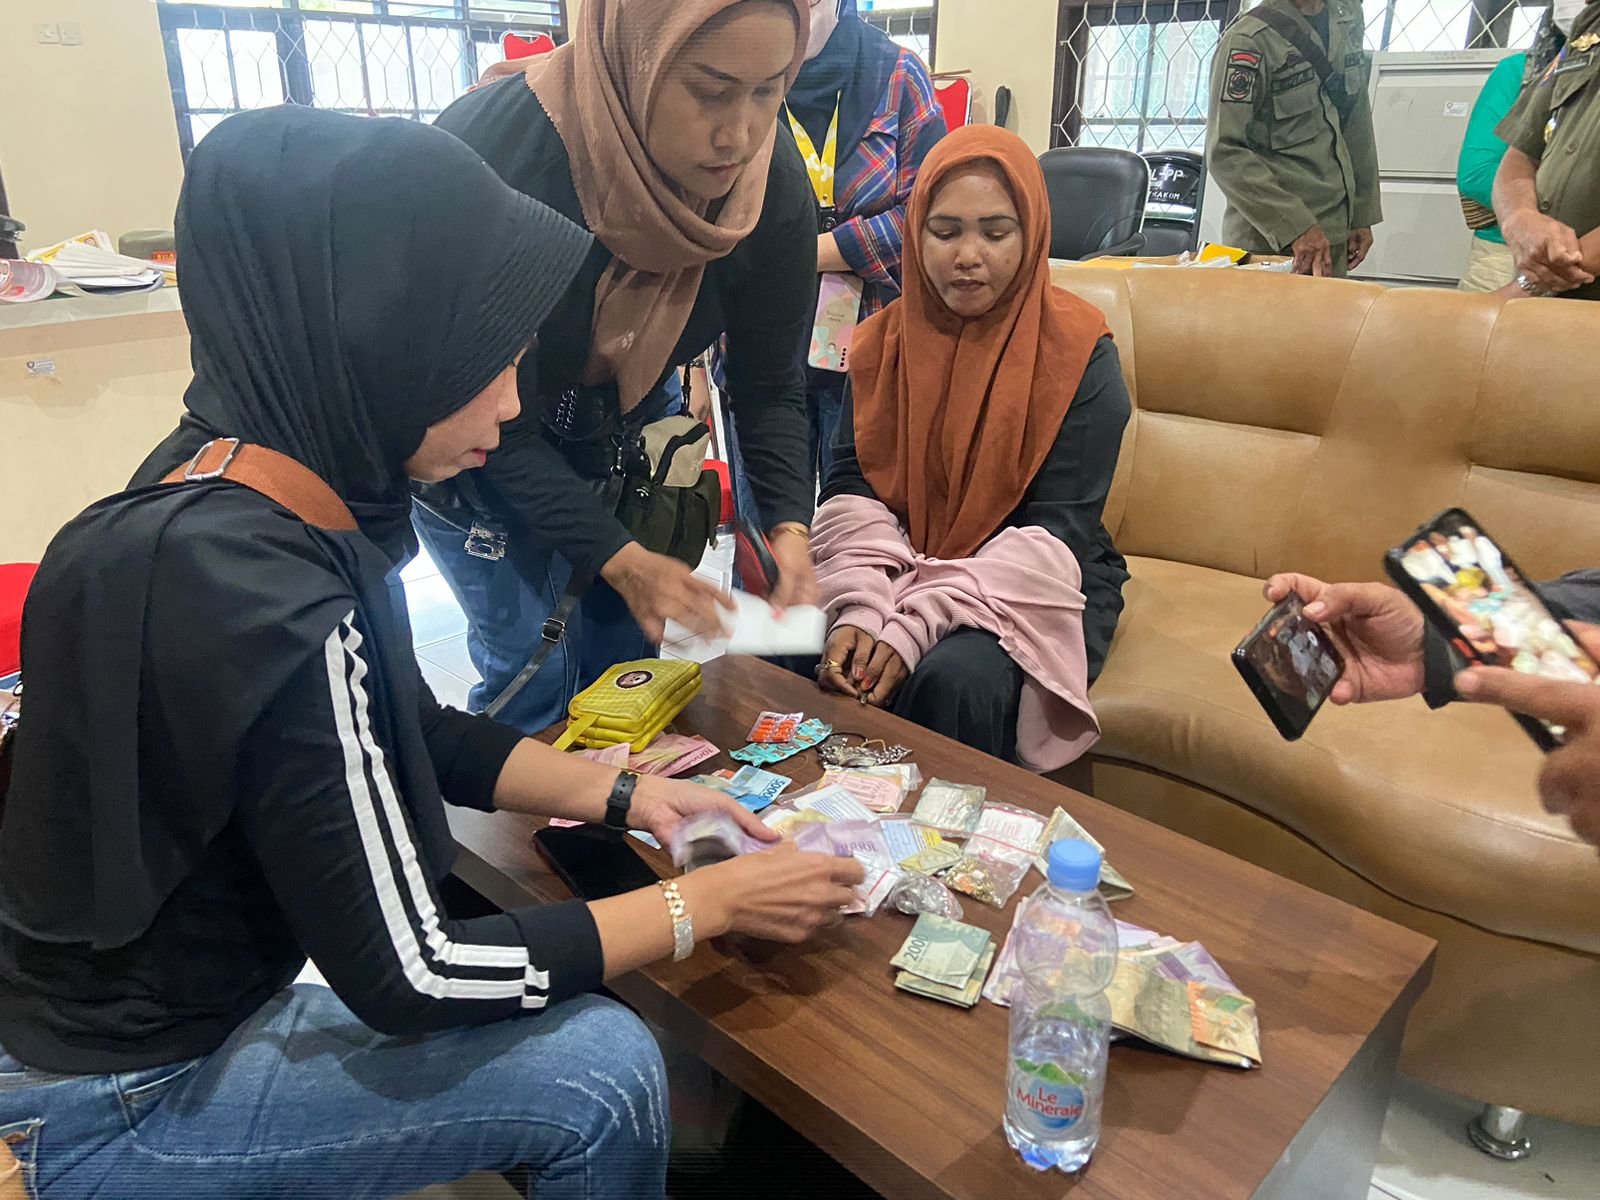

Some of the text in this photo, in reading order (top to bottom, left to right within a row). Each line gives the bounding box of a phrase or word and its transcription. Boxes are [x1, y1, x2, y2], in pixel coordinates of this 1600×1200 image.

[759, 779, 786, 802] 50000
[903, 933, 929, 961] 2000
[1016, 1087, 1083, 1118] Minerale
[1038, 1087, 1058, 1105] Le
